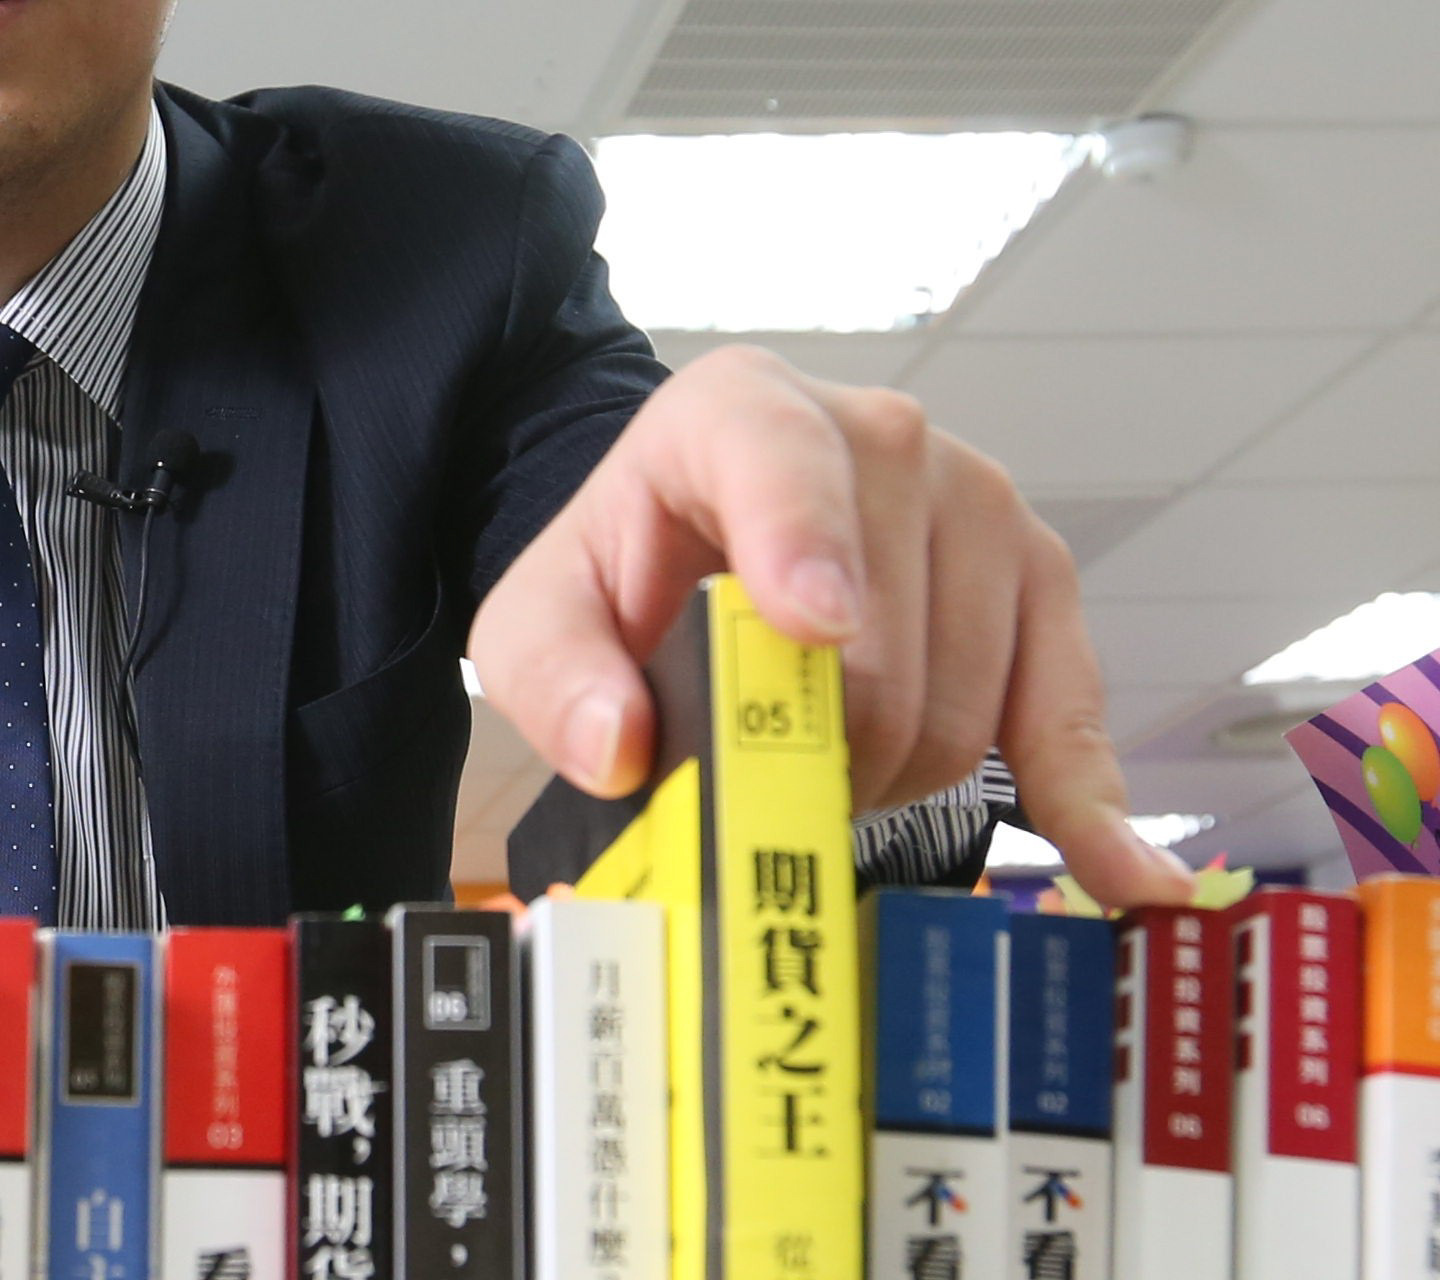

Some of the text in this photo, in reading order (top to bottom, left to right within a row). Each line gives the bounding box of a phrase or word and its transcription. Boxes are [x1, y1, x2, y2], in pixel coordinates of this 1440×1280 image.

[740, 701, 793, 738] 05
[752, 847, 831, 1160] 期貨之王
